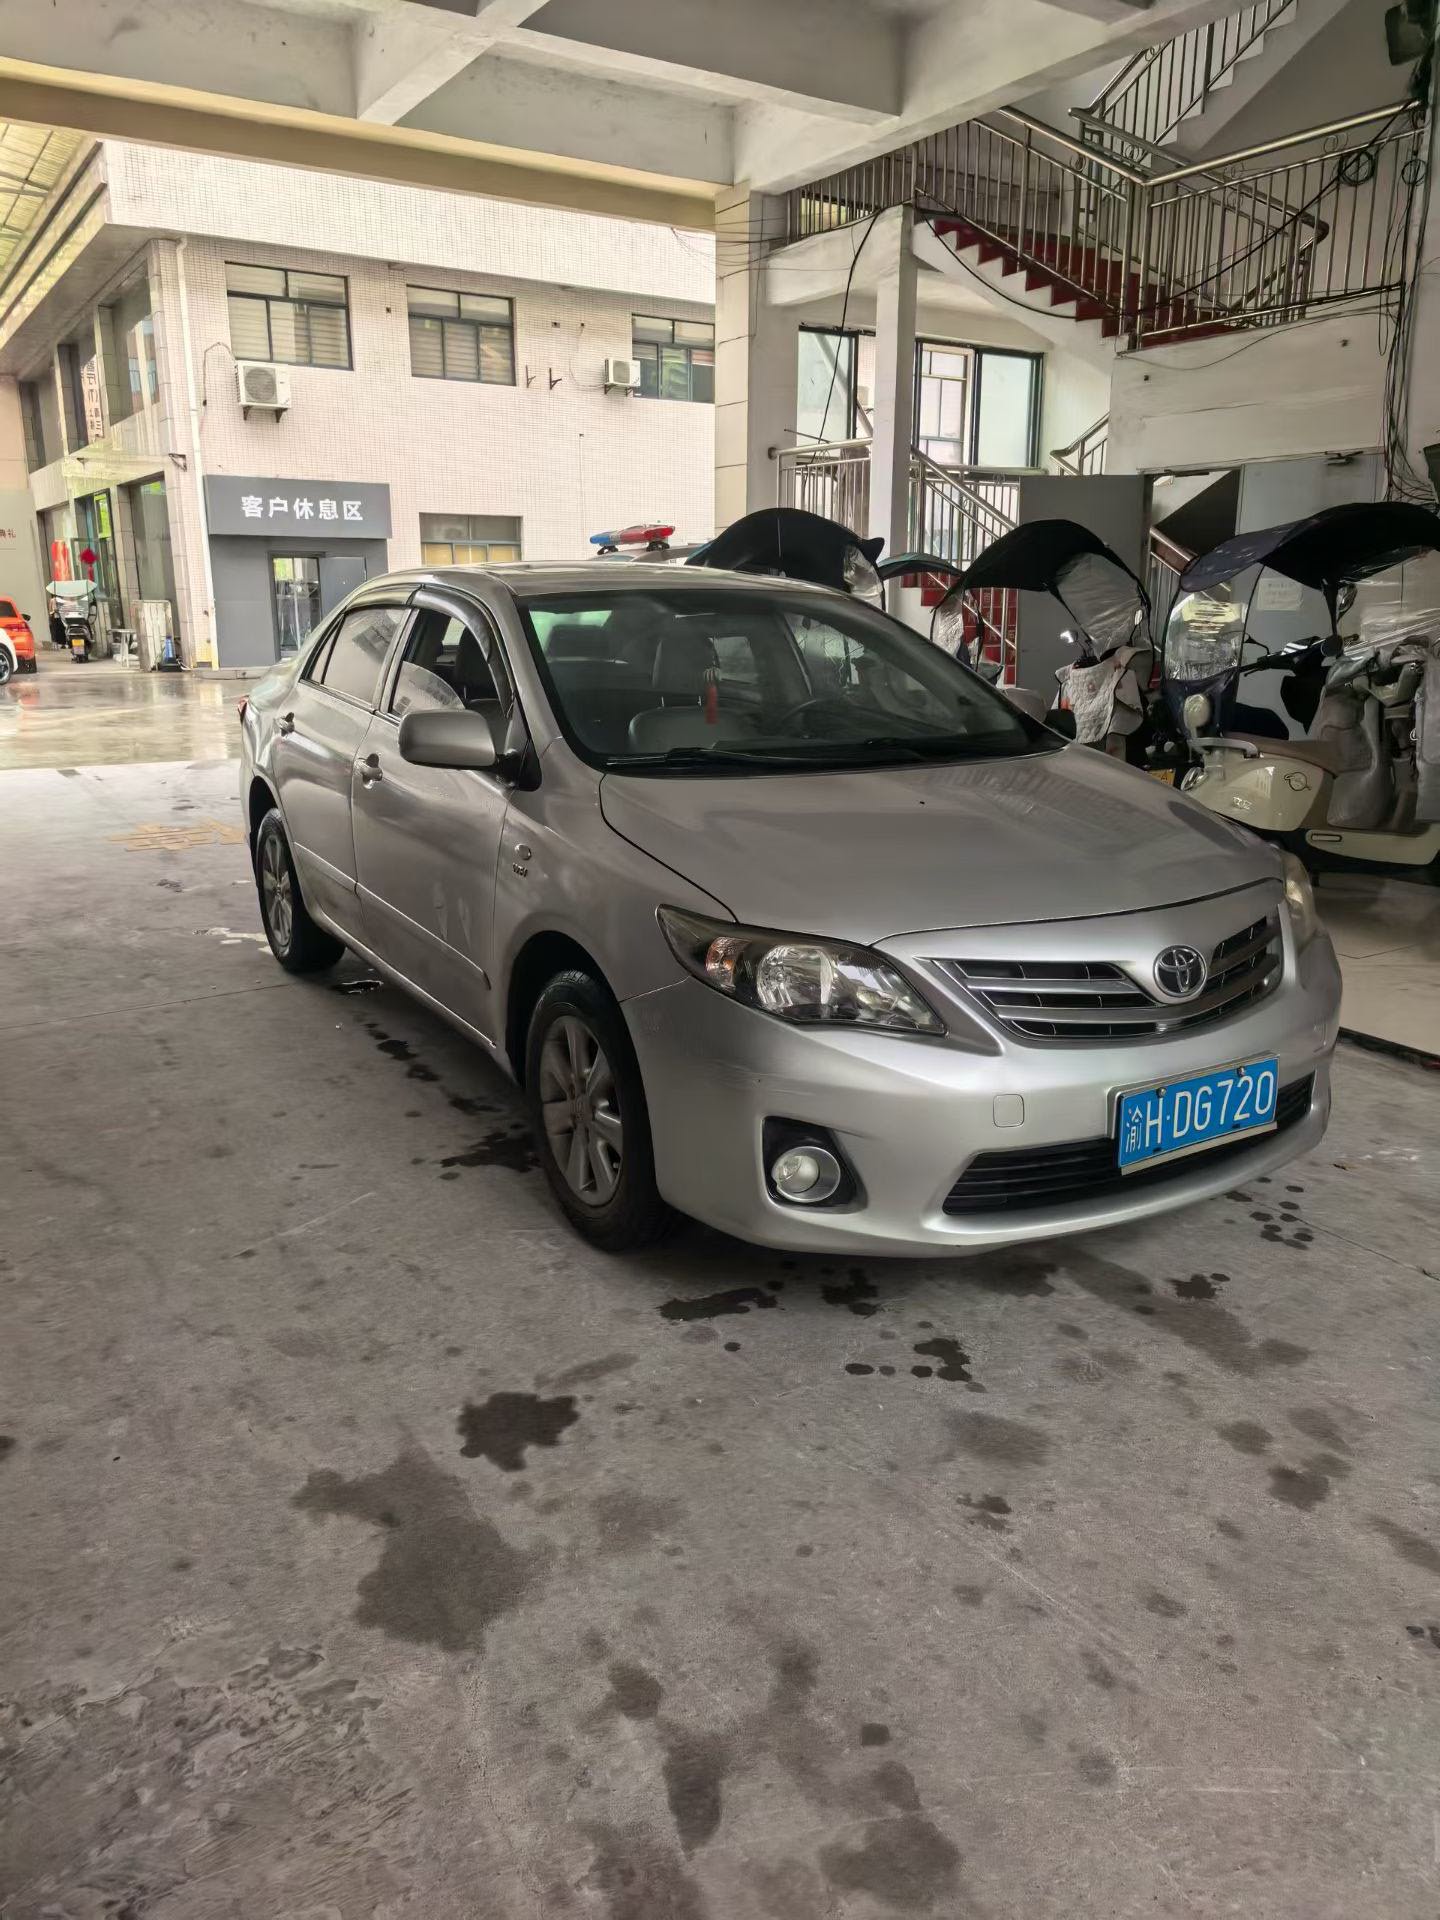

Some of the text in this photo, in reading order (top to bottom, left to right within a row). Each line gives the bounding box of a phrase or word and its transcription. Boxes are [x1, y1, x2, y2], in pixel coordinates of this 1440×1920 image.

[241, 495, 363, 520] 客户休息区
